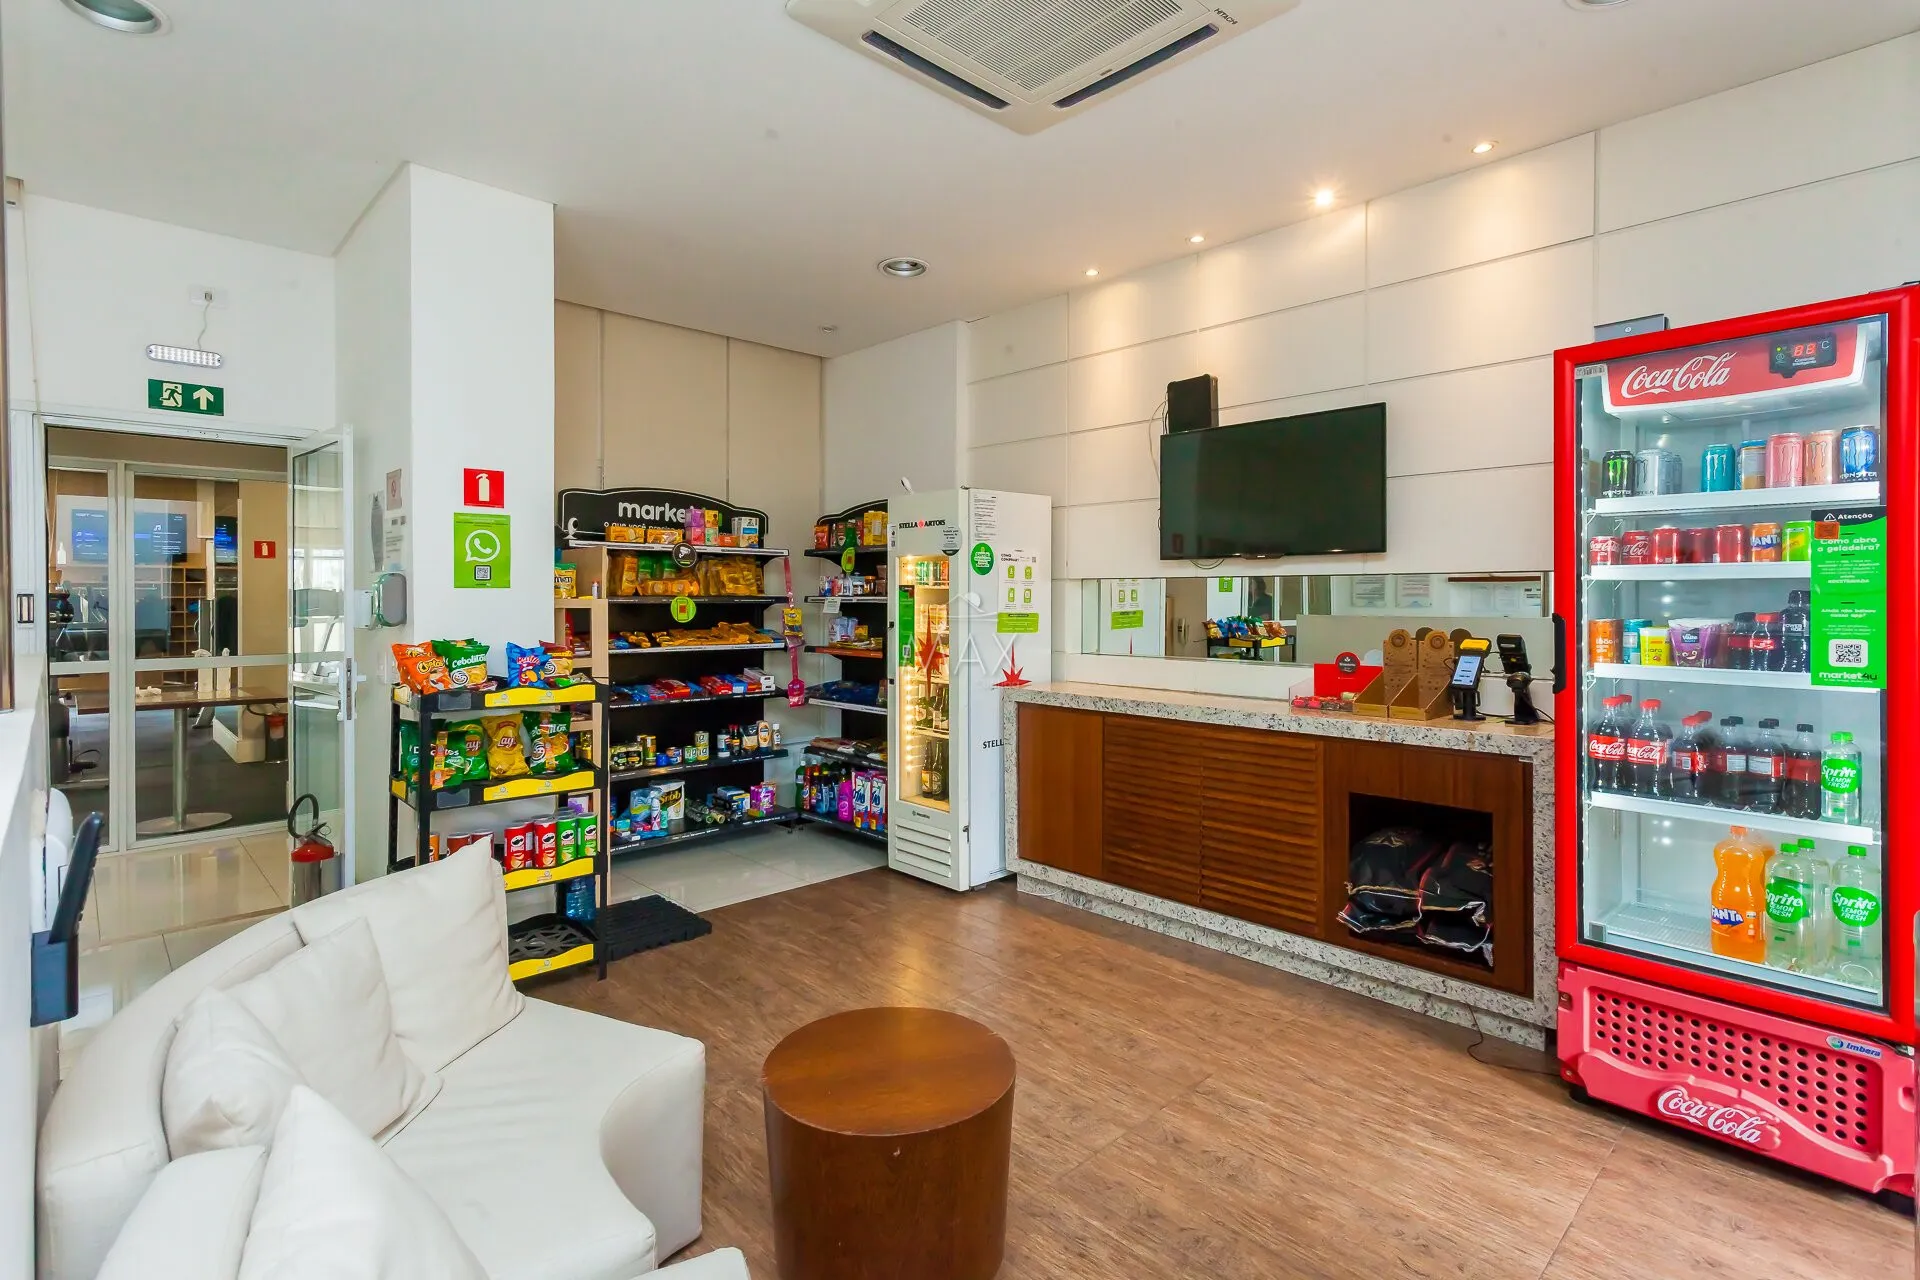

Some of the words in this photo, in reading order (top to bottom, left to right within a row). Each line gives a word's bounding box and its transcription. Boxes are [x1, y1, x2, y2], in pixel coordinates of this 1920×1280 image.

[1621, 352, 1737, 398] Coca-Cola
[618, 502, 688, 523] marke
[1837, 512, 1873, 521] Atenção
[899, 521, 918, 530] STELLA
[924, 519, 946, 528] ARTOIS
[1826, 543, 1881, 553] geladeira?
[1818, 671, 1878, 681] market4u
[1822, 765, 1857, 780] Sprite
[1833, 892, 1877, 911] Sprite
[1769, 902, 1795, 913] LEMON
[1769, 908, 1792, 918] FRESH
[1841, 906, 1869, 917] LEMON
[1711, 905, 1744, 923] FANTA
[1841, 912, 1867, 922] FRESH
[1845, 1042, 1881, 1058] Imbera
[1657, 1088, 1767, 1144] Coca-Cola
